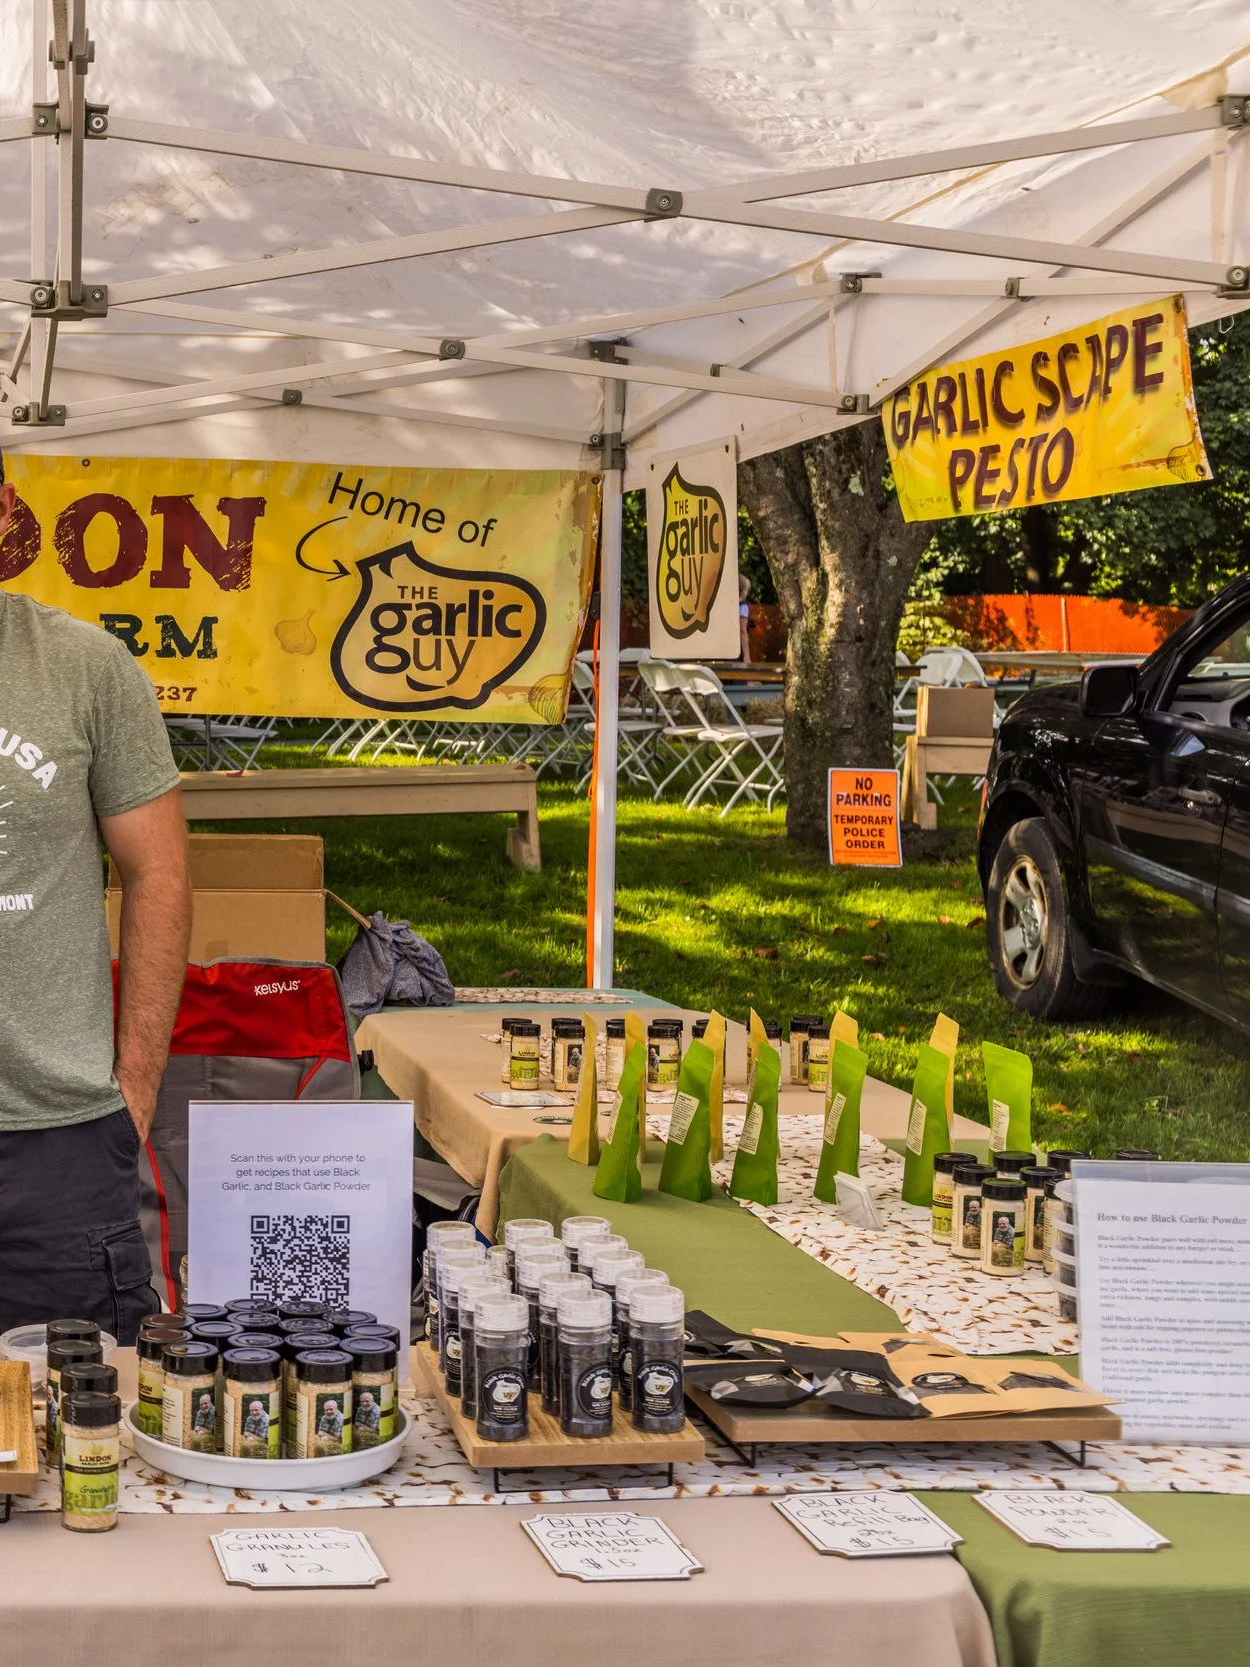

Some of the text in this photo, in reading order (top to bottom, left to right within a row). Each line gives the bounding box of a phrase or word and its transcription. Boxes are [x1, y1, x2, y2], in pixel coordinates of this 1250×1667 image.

[892, 313, 1164, 448] GARLIC SCAPE
[949, 427, 1075, 510] PESTO
[328, 472, 498, 548] Home of
[673, 499, 689, 516] THE
[666, 498, 720, 558] garlic
[665, 556, 704, 611] guy
[397, 586, 438, 601] THE
[369, 589, 524, 638] garlic
[99, 613, 219, 660] RM
[365, 637, 477, 682] guy
[855, 777, 873, 791] NO
[836, 793, 892, 807] PARKING
[834, 814, 894, 825] TEMPORARY
[843, 827, 885, 838] POLICE
[845, 839, 885, 849] ORDER
[230, 1154, 366, 1165] Scan this with your phone to
[236, 1168, 360, 1179] get recipes that use Black
[254, 1182, 272, 1191] and
[275, 1182, 301, 1191] Black
[303, 1182, 331, 1191] Garlic
[333, 1182, 371, 1191] Powder
[1097, 1212, 1248, 1225] How to use Black Garlic Powder
[79, 1454, 112, 1462] LINDON
[799, 1494, 887, 1509] BLACK
[1003, 1494, 1094, 1505] BLACK
[796, 1505, 901, 1520] GARLIC
[1007, 1505, 1117, 1518] POWDER
[546, 1516, 639, 1530] BLACK
[894, 1514, 931, 1525] Bag
[235, 1531, 330, 1541] GARLIC
[545, 1528, 645, 1540] GARLIC
[225, 1541, 351, 1552] GRANULES
[550, 1537, 665, 1550] GRINDER
